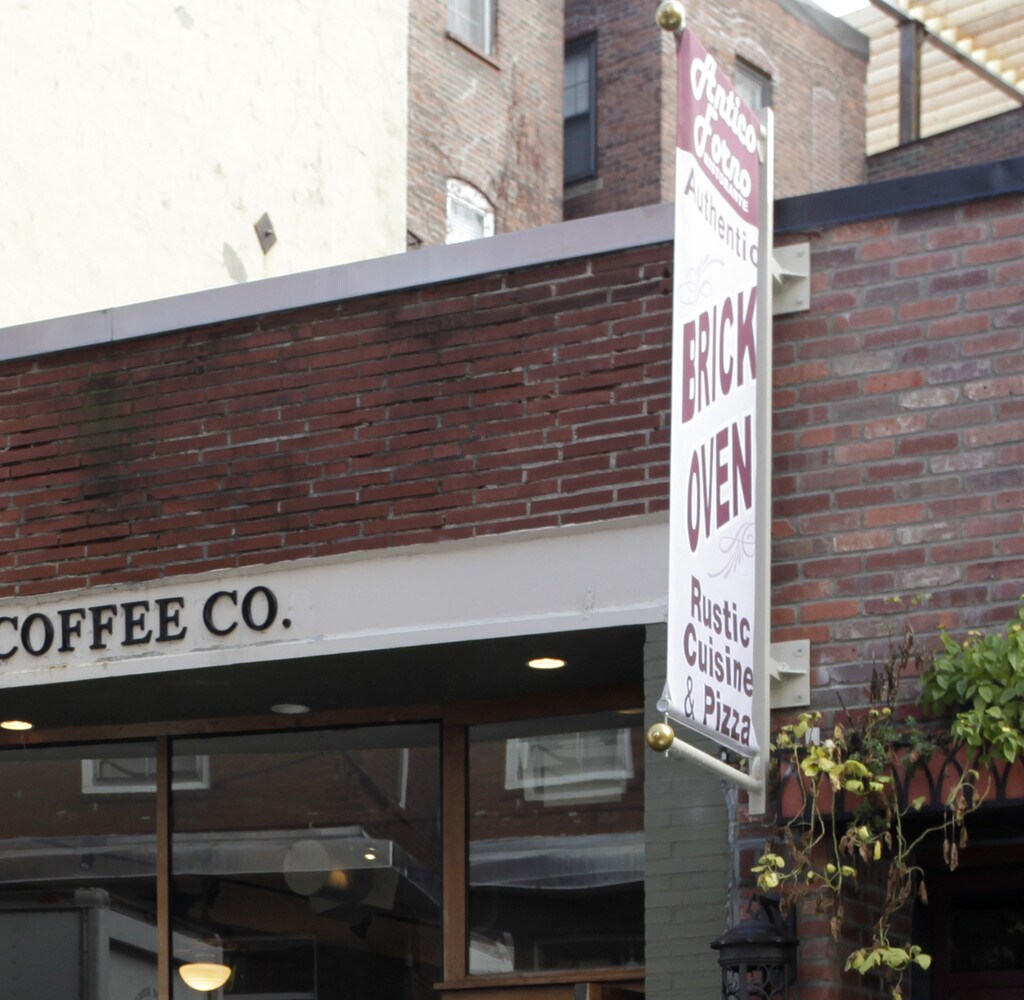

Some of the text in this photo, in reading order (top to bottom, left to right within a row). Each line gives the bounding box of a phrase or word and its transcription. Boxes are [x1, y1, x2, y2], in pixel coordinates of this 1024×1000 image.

[690, 53, 756, 153] Antico
[694, 103, 751, 198] Forno
[684, 167, 758, 268] Authentic
[682, 286, 757, 424] BRICK
[687, 415, 752, 553] OVEN
[202, 585, 292, 637] CO.
[691, 574, 751, 648] Rustic
[683, 622, 754, 698] Cuisine
[684, 675, 751, 746] & Pizza
